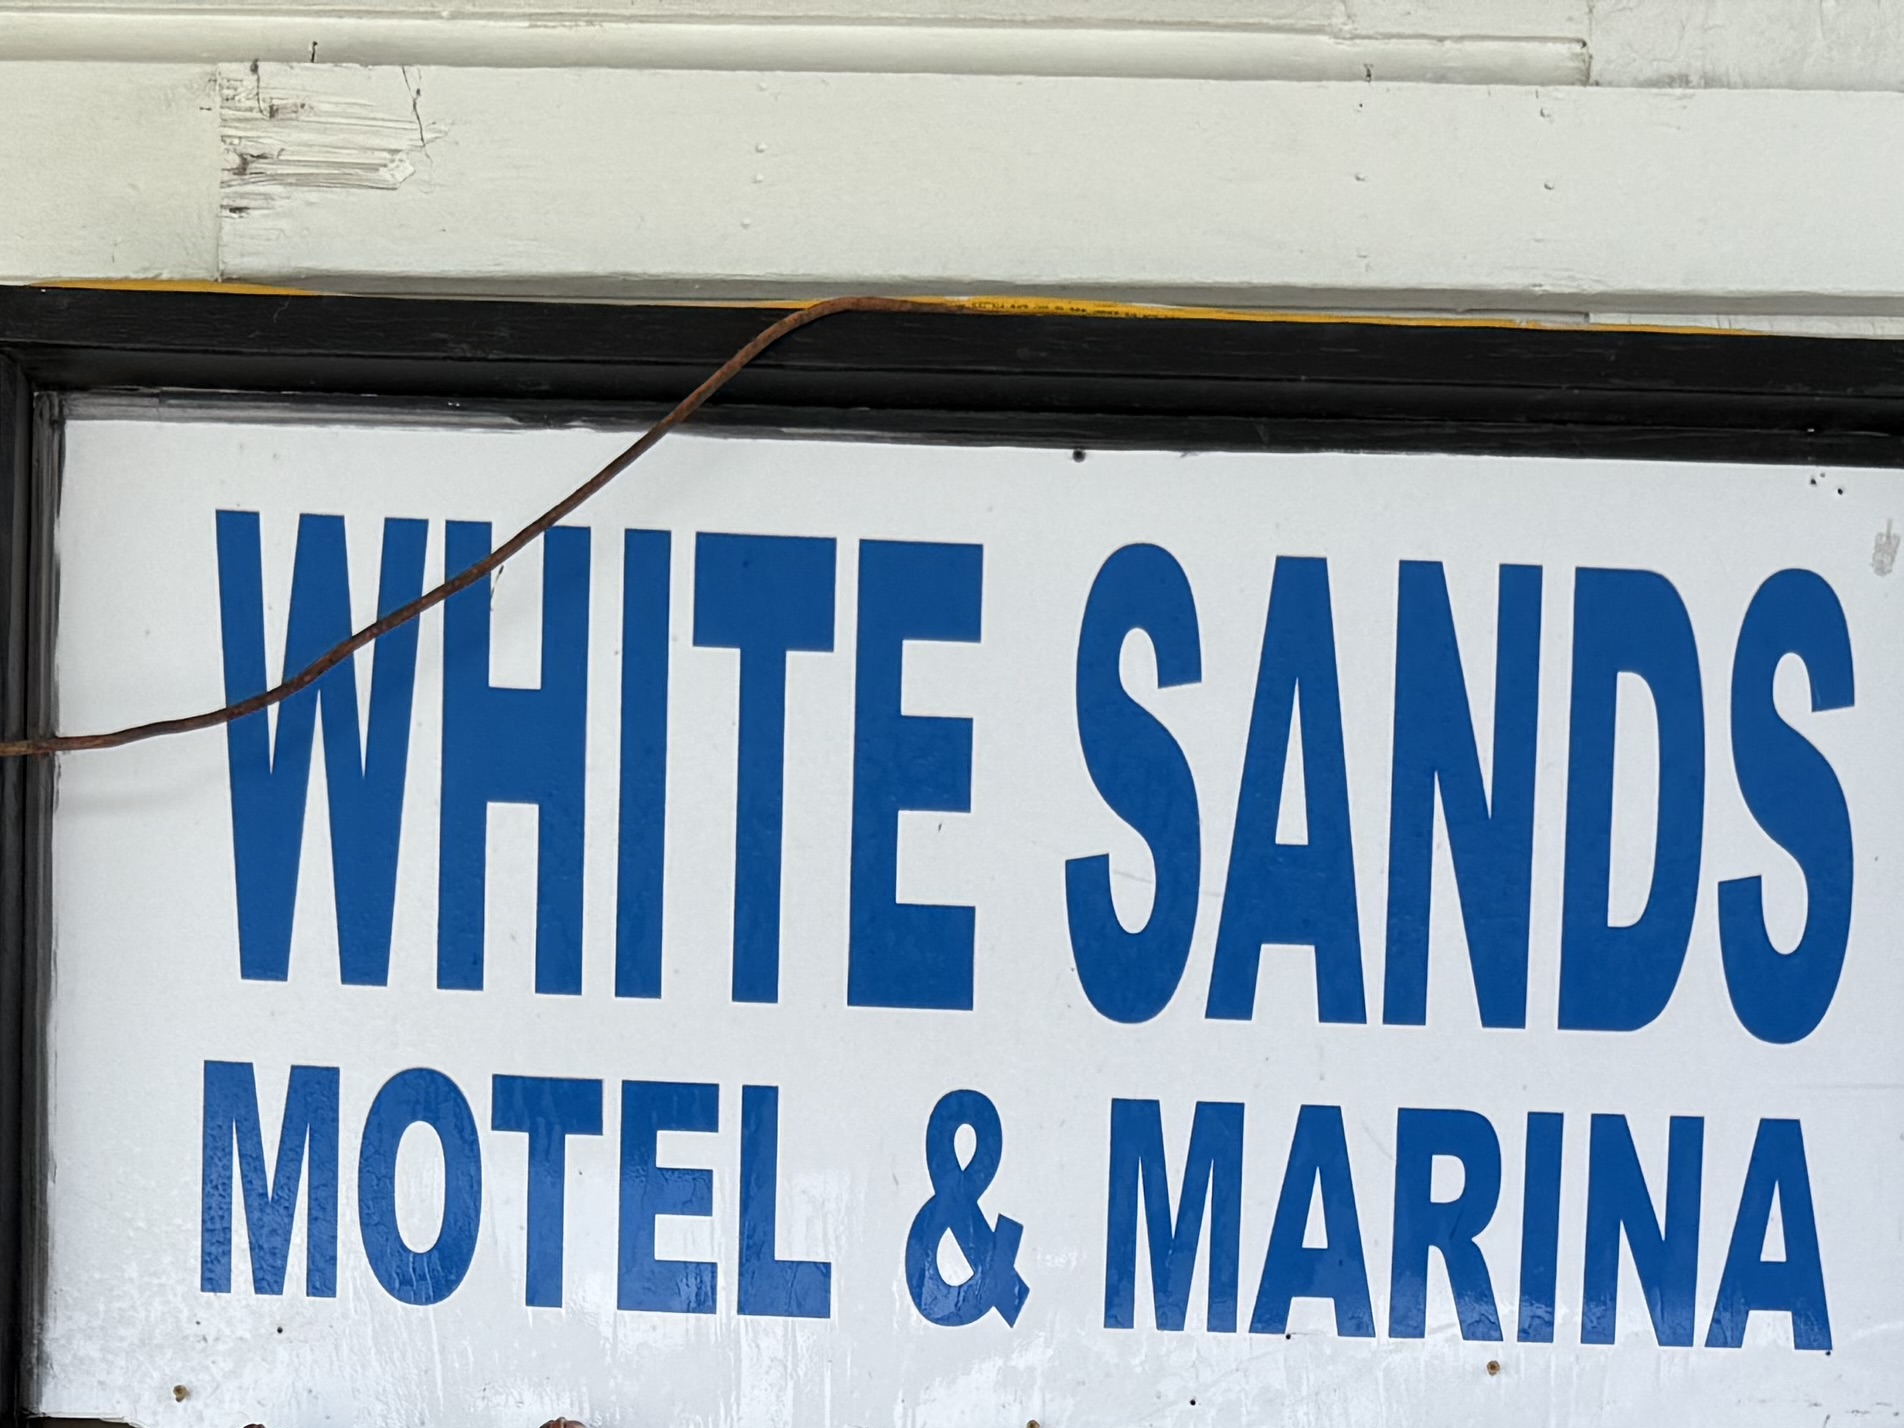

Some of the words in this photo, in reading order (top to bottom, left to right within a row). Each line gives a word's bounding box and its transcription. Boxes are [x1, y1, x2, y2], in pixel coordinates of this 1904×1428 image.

[215, 508, 984, 1011] WHITE
[1065, 542, 1856, 1045] SANDS
[200, 1060, 832, 1319] MOTEL
[904, 1088, 1030, 1328] &
[1103, 1097, 1834, 1352] MARINA
